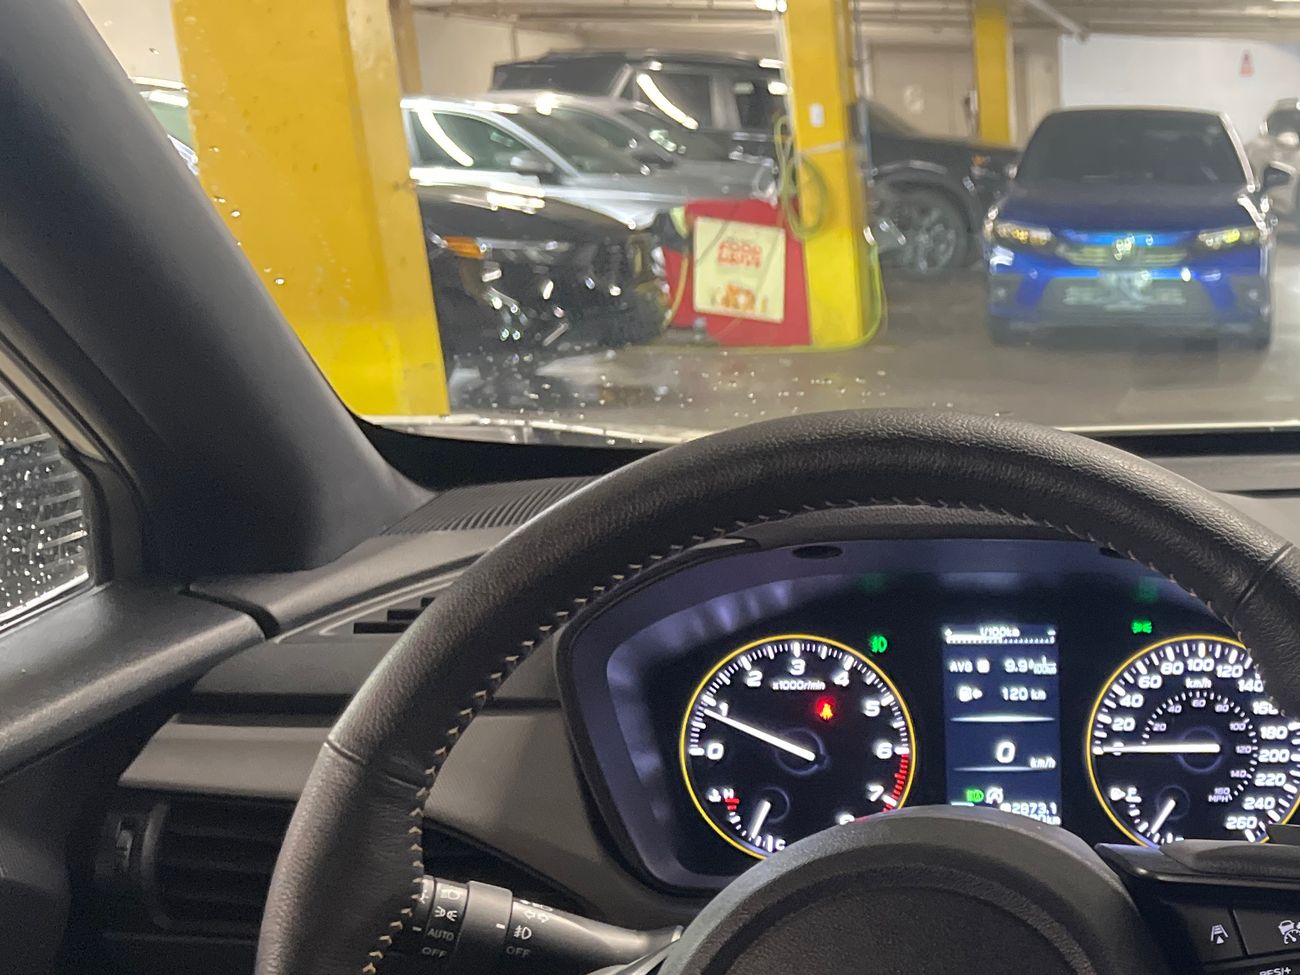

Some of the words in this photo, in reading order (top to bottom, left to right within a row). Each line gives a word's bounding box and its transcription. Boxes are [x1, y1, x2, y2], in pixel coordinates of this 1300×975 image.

[790, 659, 806, 675] 3
[1160, 662, 1184, 675] 80
[1187, 658, 1214, 672] 100
[1216, 664, 1243, 678] 120
[747, 671, 763, 687] 2
[834, 672, 850, 686] 4
[1138, 675, 1162, 689] 60
[1185, 677, 1212, 689] km/h
[1001, 687, 1029, 701] 120
[1119, 693, 1144, 708] 40
[865, 701, 880, 717] 5
[1167, 704, 1182, 713] 40
[1191, 699, 1206, 708] 60
[1214, 703, 1229, 713] 80
[1111, 718, 1136, 731] 20
[1152, 722, 1167, 732] 20
[1230, 722, 1246, 731] 100
[1260, 726, 1288, 740] 180
[706, 744, 724, 760] 0
[876, 744, 892, 759] 6
[996, 741, 1015, 763] 0
[1258, 749, 1290, 763] 200
[1255, 773, 1286, 787] 220
[867, 786, 883, 800] 7
[1243, 797, 1275, 811] 240
[1225, 815, 1257, 830] 260
[427, 928, 455, 941] AUTO
[422, 946, 448, 958] OFF
[506, 945, 531, 958] OFF
